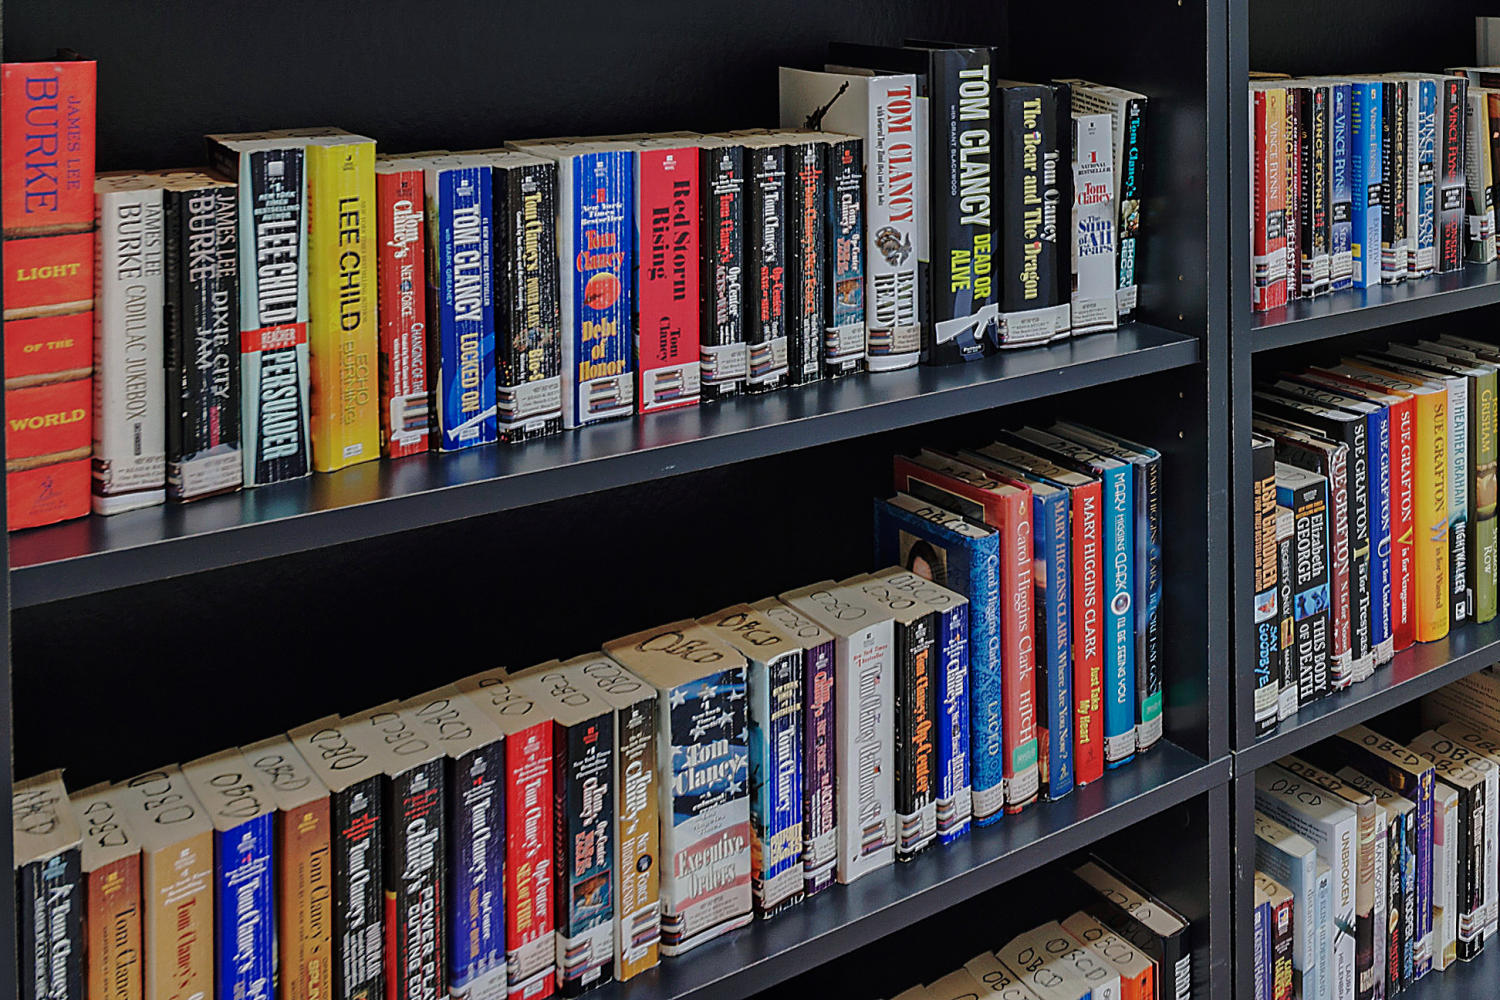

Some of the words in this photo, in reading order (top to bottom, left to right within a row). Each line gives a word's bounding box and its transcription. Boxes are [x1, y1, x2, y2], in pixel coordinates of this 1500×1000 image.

[887, 86, 912, 134] TOM
[959, 65, 990, 122] TOM
[1023, 98, 1042, 128] The
[25, 76, 59, 214] BURKE
[67, 95, 81, 151] JAMES
[67, 158, 81, 190] LEE
[1023, 132, 1042, 172] Bear
[1044, 151, 1060, 185] Tom
[888, 144, 913, 224] CLANCY
[960, 129, 990, 226] CLANCY
[1023, 176, 1042, 205] and
[1078, 192, 1112, 206] Clancy
[1084, 183, 1106, 195] Tom
[216, 194, 235, 247] JAMES
[338, 197, 360, 247] LEE
[673, 180, 690, 221] Red
[1040, 189, 1060, 243] Clancy
[117, 203, 141, 280] BURKE
[145, 203, 161, 250] JAMES
[188, 192, 213, 282] BURKE
[453, 204, 480, 245] TOM
[650, 208, 670, 281] Rising
[1023, 208, 1042, 239] The
[16, 263, 80, 281] LIGHT
[145, 256, 161, 277] LEE
[576, 250, 625, 274] Clancy
[673, 223, 689, 300] Storm
[952, 250, 971, 293] ALIVE
[974, 234, 990, 275] DEAD
[1020, 242, 1042, 300] Dragon
[258, 263, 298, 325] CHILD
[339, 251, 360, 331] CHILD
[454, 248, 481, 323] CLANCY
[974, 277, 990, 299] OR
[126, 284, 147, 352] CADILLAC
[581, 318, 618, 341] Debt
[23, 341, 42, 353] OF
[46, 338, 74, 350] THE
[461, 332, 477, 380] LOCKED
[126, 356, 147, 421] JUKEBOX
[262, 351, 299, 462] PERSUADER
[461, 388, 477, 413] ON
[10, 408, 85, 431] WORLD
[1354, 424, 1365, 458] SUE
[1401, 411, 1411, 443] SUE
[1262, 477, 1276, 504] LISA
[1355, 459, 1367, 540] GRAFTON
[1401, 445, 1412, 522] GRAFTON
[1084, 496, 1095, 540] MARY
[1263, 507, 1277, 590] GARDNER
[1297, 517, 1310, 585] GEORGE
[1311, 513, 1324, 578] Elizabeth
[1084, 543, 1096, 608] HIGGINS
[1084, 610, 1096, 660] CLARK
[1313, 616, 1326, 652] THIS
[1300, 640, 1313, 700] DEATH
[1314, 652, 1327, 692] BODY
[687, 739, 728, 765] Tom
[1364, 735, 1419, 766] OBCD
[676, 758, 742, 794] Clancy
[1272, 780, 1321, 806] OBCD
[310, 842, 329, 881] Tom
[677, 835, 745, 876] Executive
[1341, 830, 1350, 907] UNBROKEN
